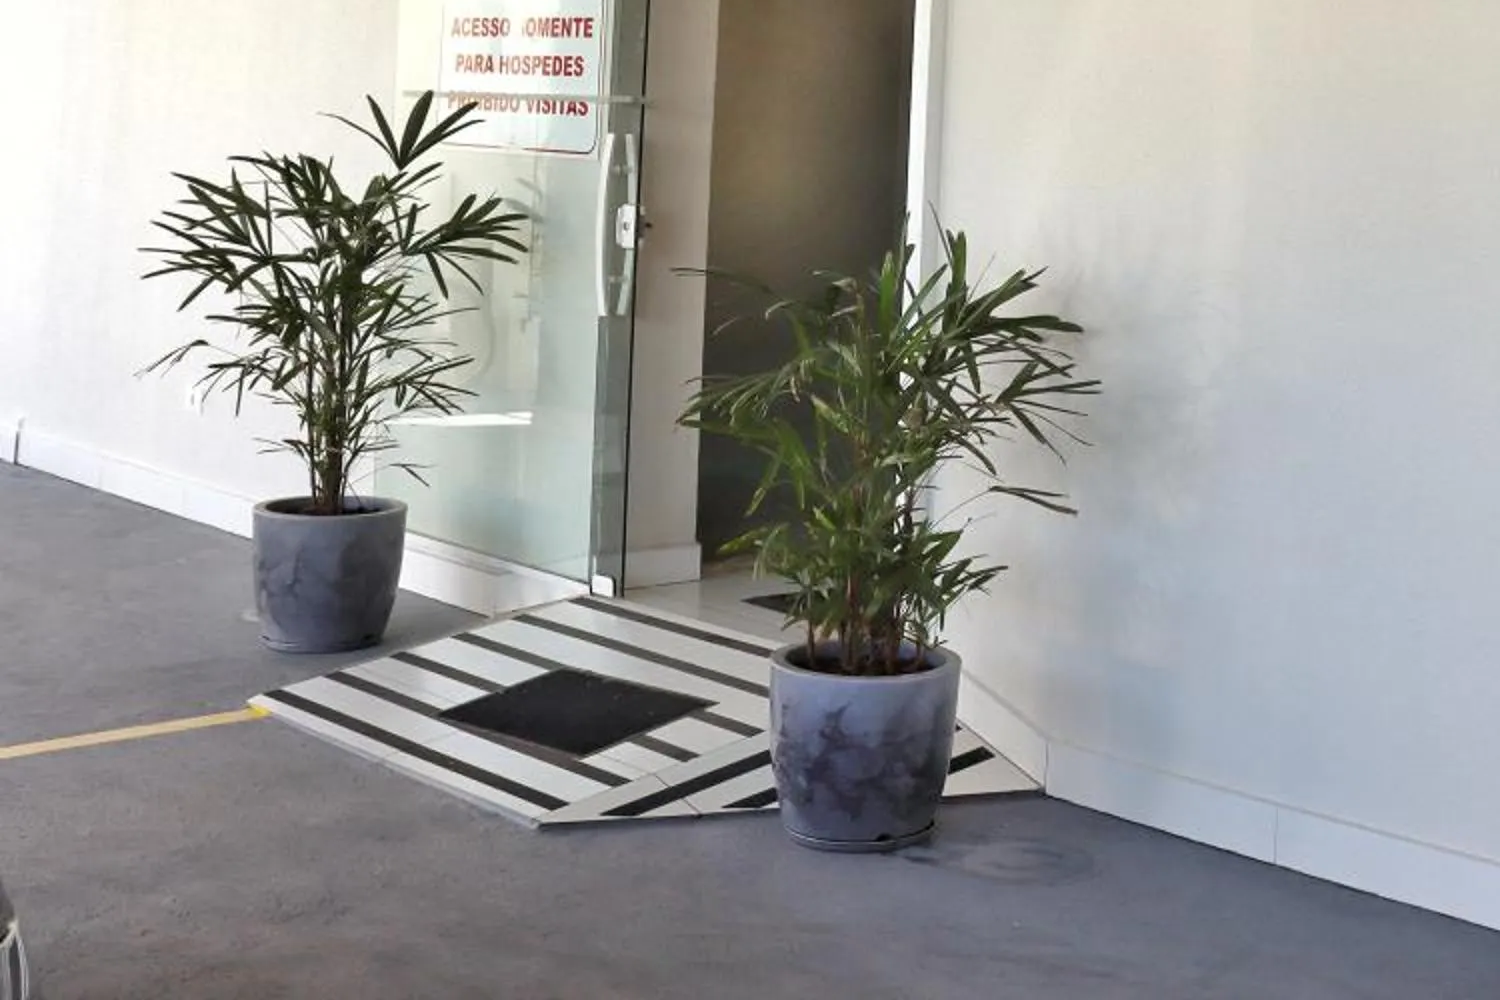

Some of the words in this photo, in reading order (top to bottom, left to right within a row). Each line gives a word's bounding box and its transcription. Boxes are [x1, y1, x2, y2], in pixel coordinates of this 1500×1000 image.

[451, 16, 511, 38] ACESSO
[521, 16, 594, 39] OMENTE
[455, 53, 495, 75] PARA
[499, 54, 585, 77] HOSPEDES
[526, 97, 589, 117] VISITAS
